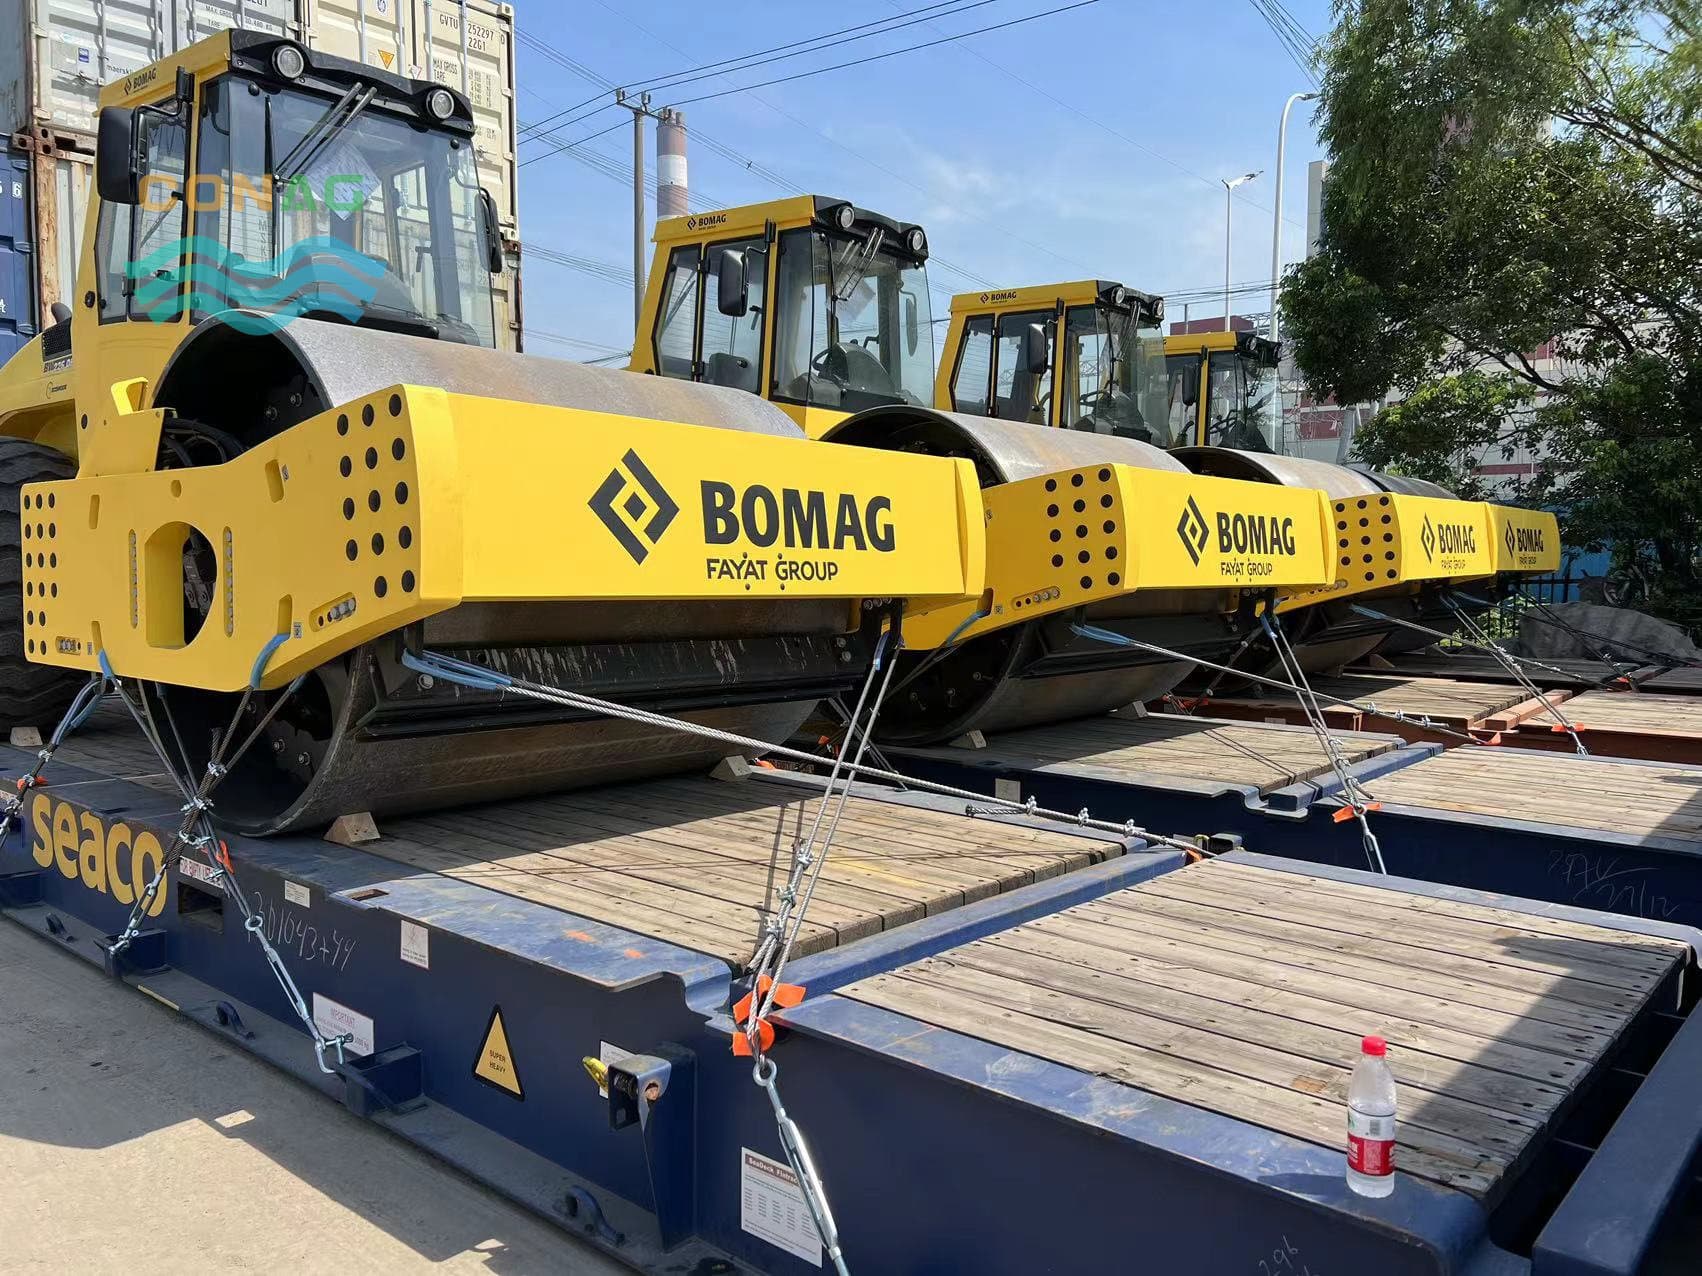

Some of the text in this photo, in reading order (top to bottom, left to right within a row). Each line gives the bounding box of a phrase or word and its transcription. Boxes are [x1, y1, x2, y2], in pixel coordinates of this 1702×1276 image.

[440, 14, 458, 29] GVTU
[467, 23, 494, 41] 252297
[468, 36, 486, 51] 22G1
[133, 68, 157, 89] BOMAG
[698, 213, 727, 227] BOMAG
[990, 291, 1017, 301] BOMAG
[700, 479, 896, 552] BOMAG
[1216, 511, 1296, 556] BOMAG
[1437, 524, 1476, 554] BOMAG
[1516, 528, 1544, 553] BOMAG
[706, 558, 839, 581] FAYAT GROUP
[1220, 562, 1273, 576] FAYAT GROUP
[32, 793, 168, 917] seaco
[489, 1049, 506, 1063] SUPER
[489, 1061, 506, 1074] HEAVY
